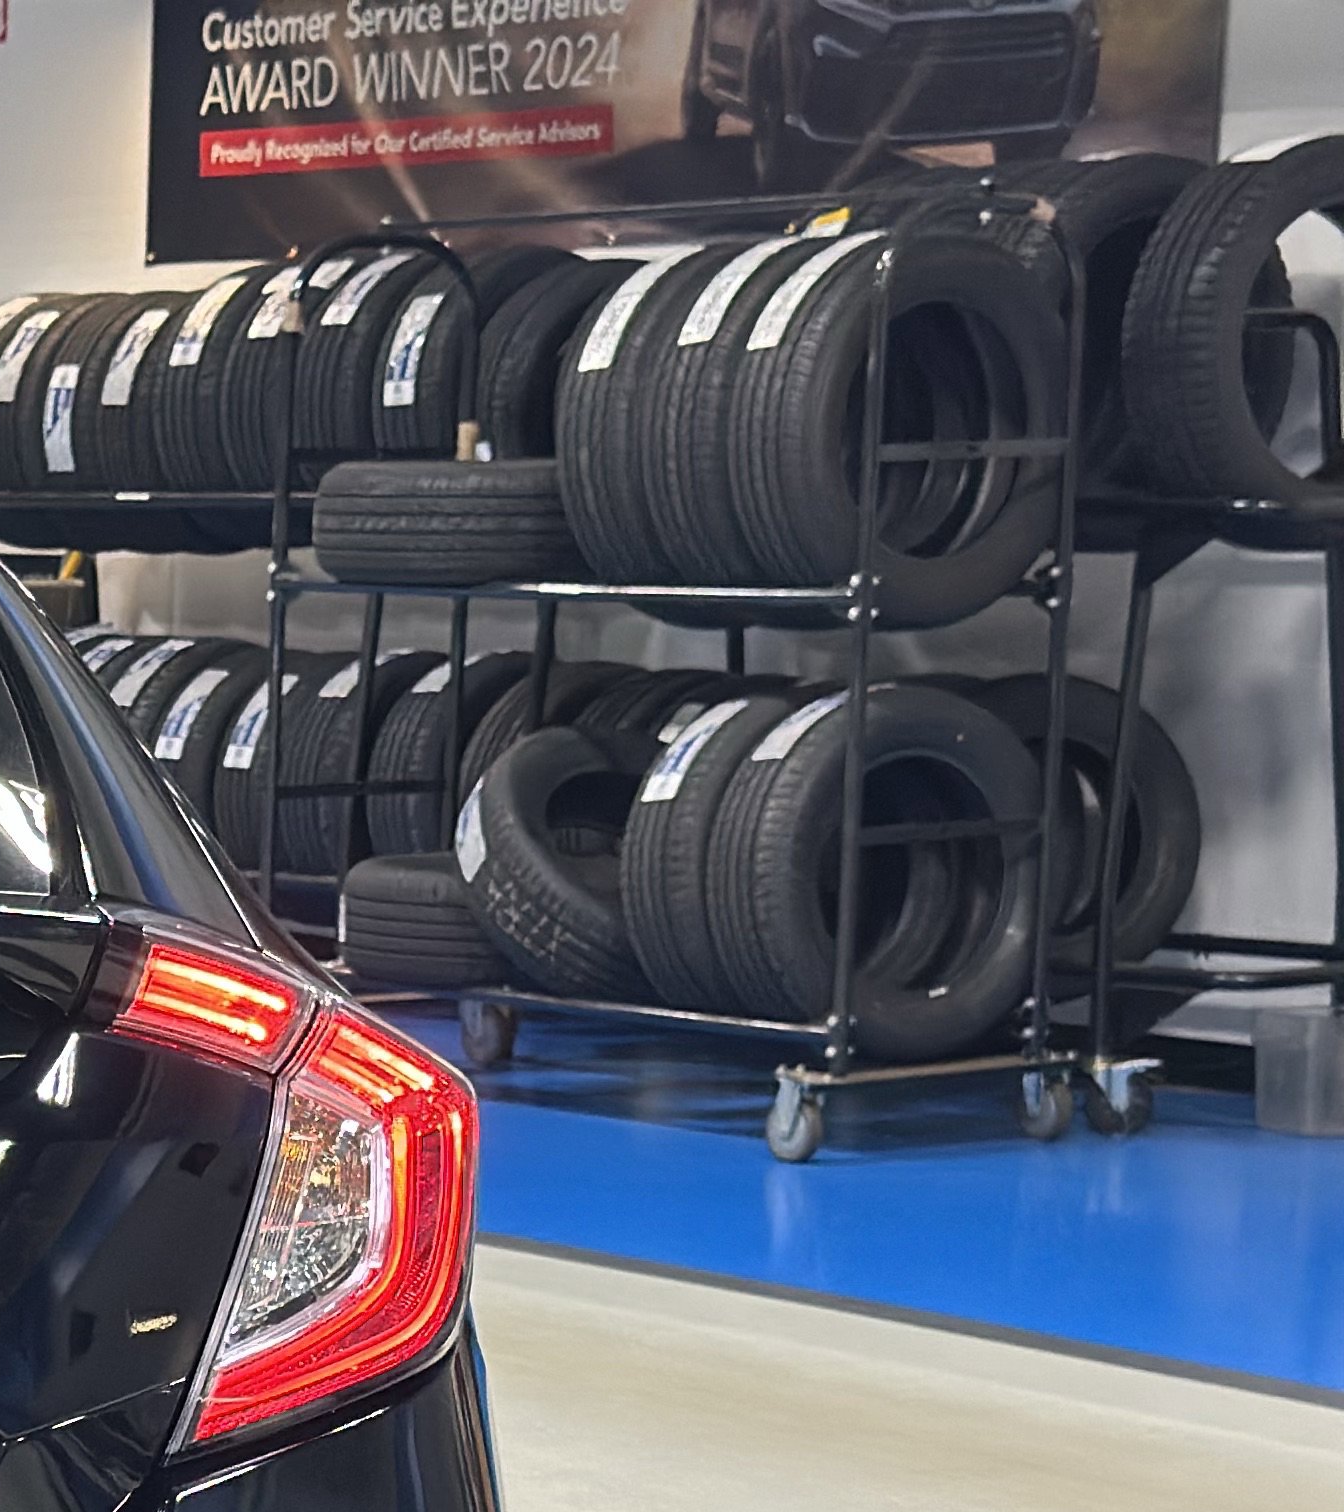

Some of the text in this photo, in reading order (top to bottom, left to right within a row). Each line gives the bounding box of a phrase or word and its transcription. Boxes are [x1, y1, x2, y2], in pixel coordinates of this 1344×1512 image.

[202, 11, 336, 51] Customer
[343, 0, 443, 40] Service
[199, 30, 622, 117] AWARD WINNER 2024
[210, 139, 262, 168] Proudly
[373, 131, 406, 154] Our
[409, 126, 474, 152] Certified
[476, 124, 535, 148] Service
[538, 119, 601, 144] Advisors
